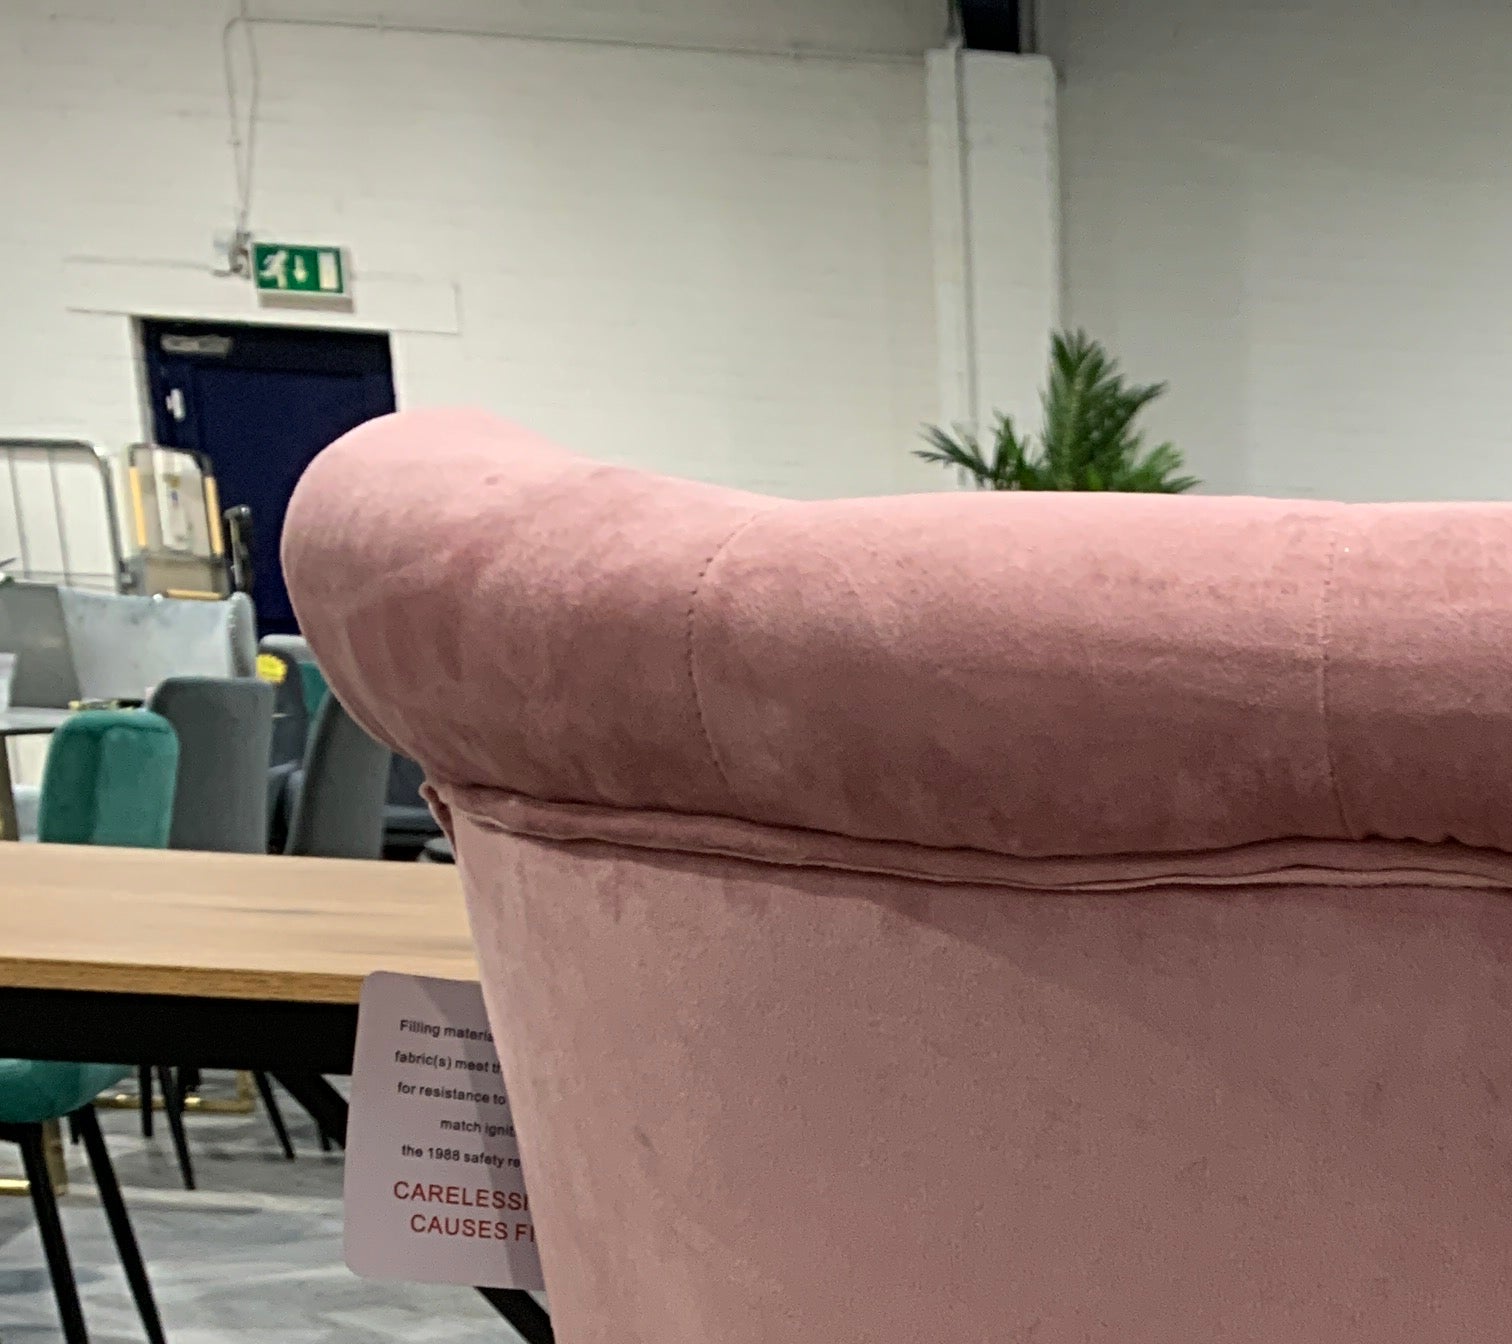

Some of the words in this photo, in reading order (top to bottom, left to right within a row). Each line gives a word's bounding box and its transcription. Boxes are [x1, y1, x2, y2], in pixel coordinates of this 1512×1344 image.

[400, 1019, 441, 1038] Filling
[394, 1050, 452, 1070] fabric(s)
[455, 1059, 489, 1073] meet
[397, 1081, 416, 1094] for
[419, 1085, 490, 1103] resistance
[492, 1094, 507, 1105] to
[440, 1119, 481, 1133] match
[401, 1144, 423, 1158] the
[428, 1147, 460, 1162] 1988
[464, 1152, 504, 1169] safety
[508, 1158, 522, 1169] re
[410, 1214, 508, 1241] CAUSES
[515, 1223, 536, 1243] FI
